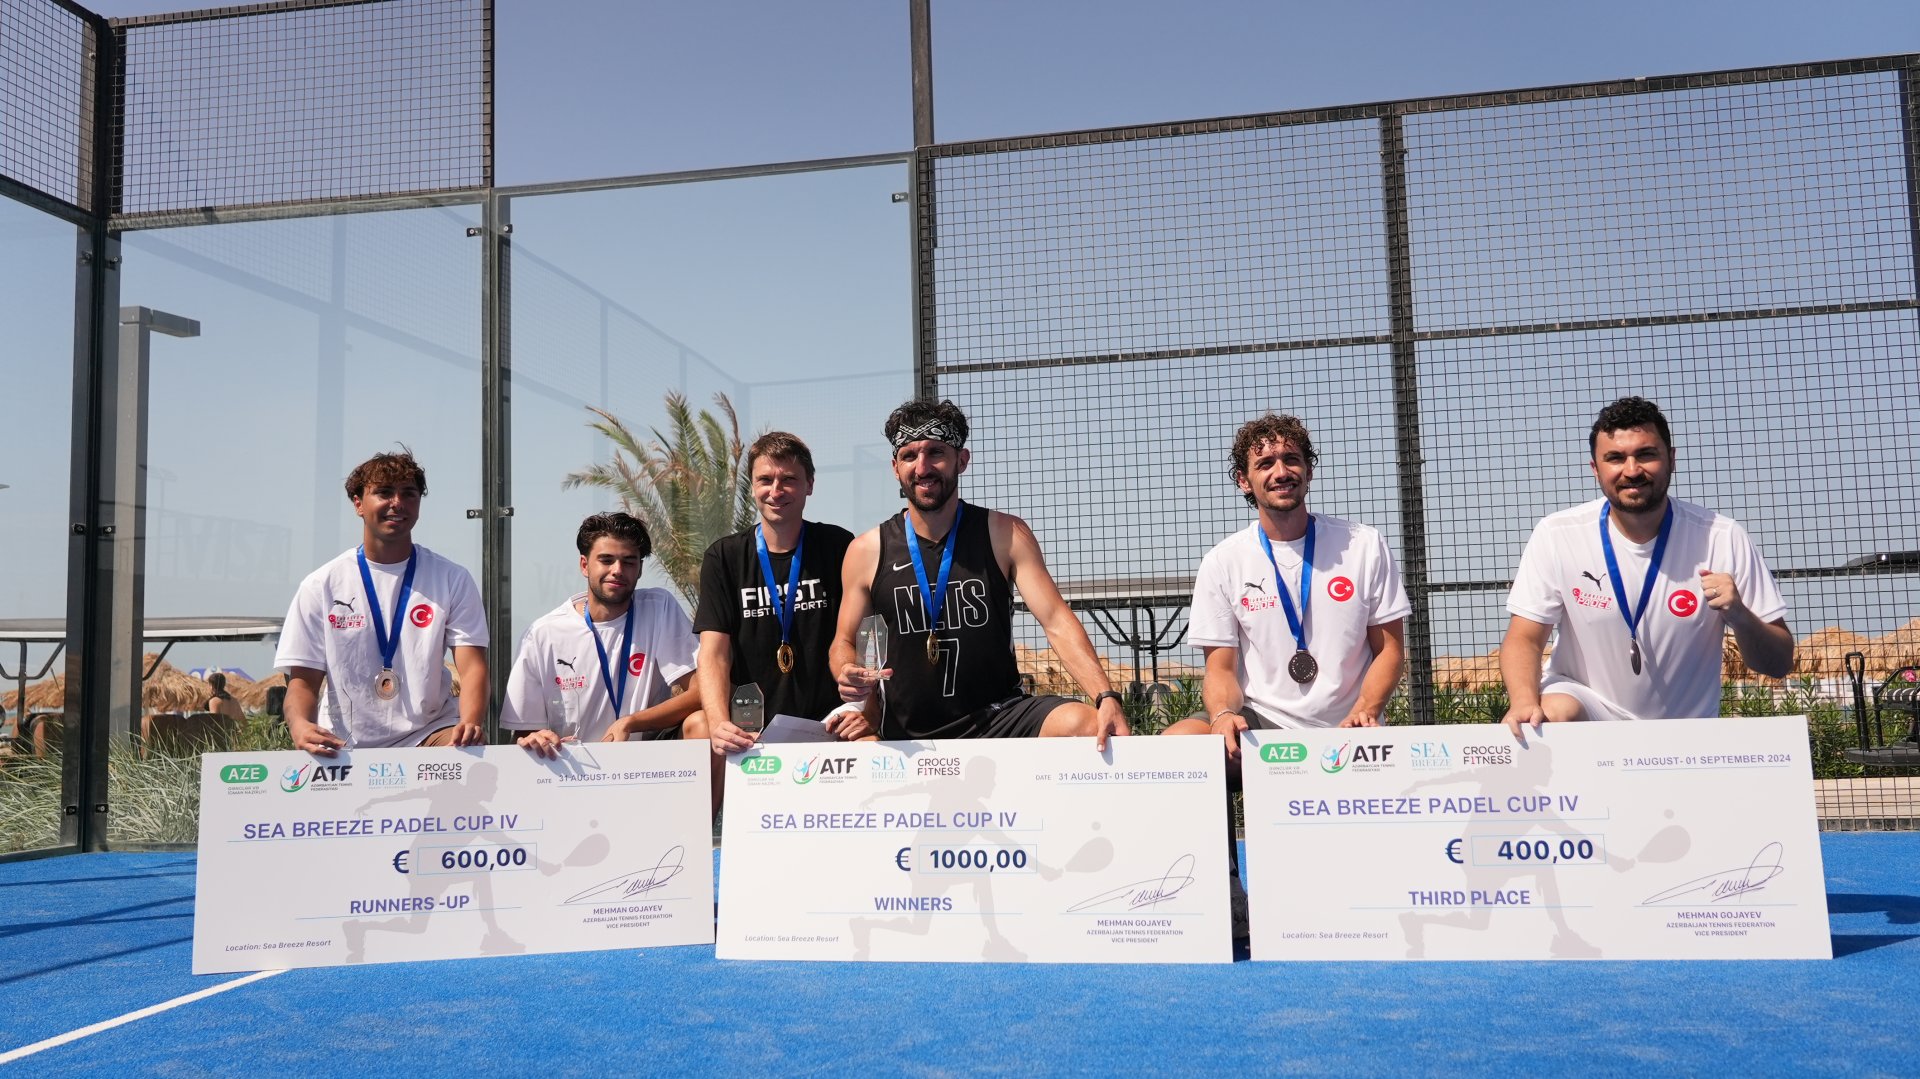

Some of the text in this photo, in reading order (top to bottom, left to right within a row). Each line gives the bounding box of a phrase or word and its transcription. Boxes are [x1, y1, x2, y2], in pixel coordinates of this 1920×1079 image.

[743, 607, 770, 618] BEST
[791, 599, 828, 613] PORTS
[934, 638, 960, 697] 7
[1268, 746, 1299, 760] AZE
[1352, 745, 1394, 762] ATF
[1410, 742, 1450, 758] SEA
[1463, 745, 1512, 755] CROCUS
[418, 763, 462, 772] CROCUS
[747, 759, 775, 772] AZE
[820, 758, 857, 775] ATF
[871, 755, 906, 771] SEA
[917, 757, 961, 767] CROCUS
[1623, 758, 1634, 766] 31
[1685, 756, 1697, 765] 01
[1700, 754, 1765, 765] SEPTEMBER
[1768, 754, 1791, 763] 2024
[228, 767, 260, 780] AZE
[311, 765, 353, 782] ATF
[368, 762, 407, 778] SEA
[536, 777, 552, 785] DATE
[559, 774, 569, 782] 31
[612, 772, 621, 781] 01
[623, 770, 676, 780] SEPTEMBER
[678, 769, 697, 778] 2024
[1058, 772, 1069, 781] 31
[1114, 772, 1124, 780] 01
[1127, 771, 1185, 780] SEPTEMBER
[1187, 771, 1208, 779] 2024
[368, 778, 407, 786] BREEZE
[1288, 795, 1579, 816] SEA BREEZE PADEL CUP IV
[243, 814, 518, 839] SEA BREEZE PADEL CUP IV
[761, 811, 1017, 829] SEA BREEZE PADEL CUP IV
[1445, 838, 1594, 864] € 400,00
[392, 847, 527, 874] € 600,00
[895, 847, 1027, 873] € 1000,00
[874, 896, 952, 911] WINNERS
[1408, 890, 1531, 905] THIRD PLACE
[350, 897, 435, 914] RUNNERS
[593, 905, 663, 915] MEHMAN GOJAYEV
[618, 914, 638, 922] TENNIS
[639, 913, 673, 921] FEDERATION
[1097, 918, 1172, 927] MEHMAN GOJAYEV
[1677, 911, 1762, 919] MEHMAN GOJAYEV
[619, 921, 650, 929] PRESIDENT
[744, 934, 776, 943] Location:
[792, 934, 815, 942] Breeze
[1282, 931, 1388, 939] Location: Sea Breeze Resort
[225, 939, 331, 952] Location: Sea Breeze Resort
